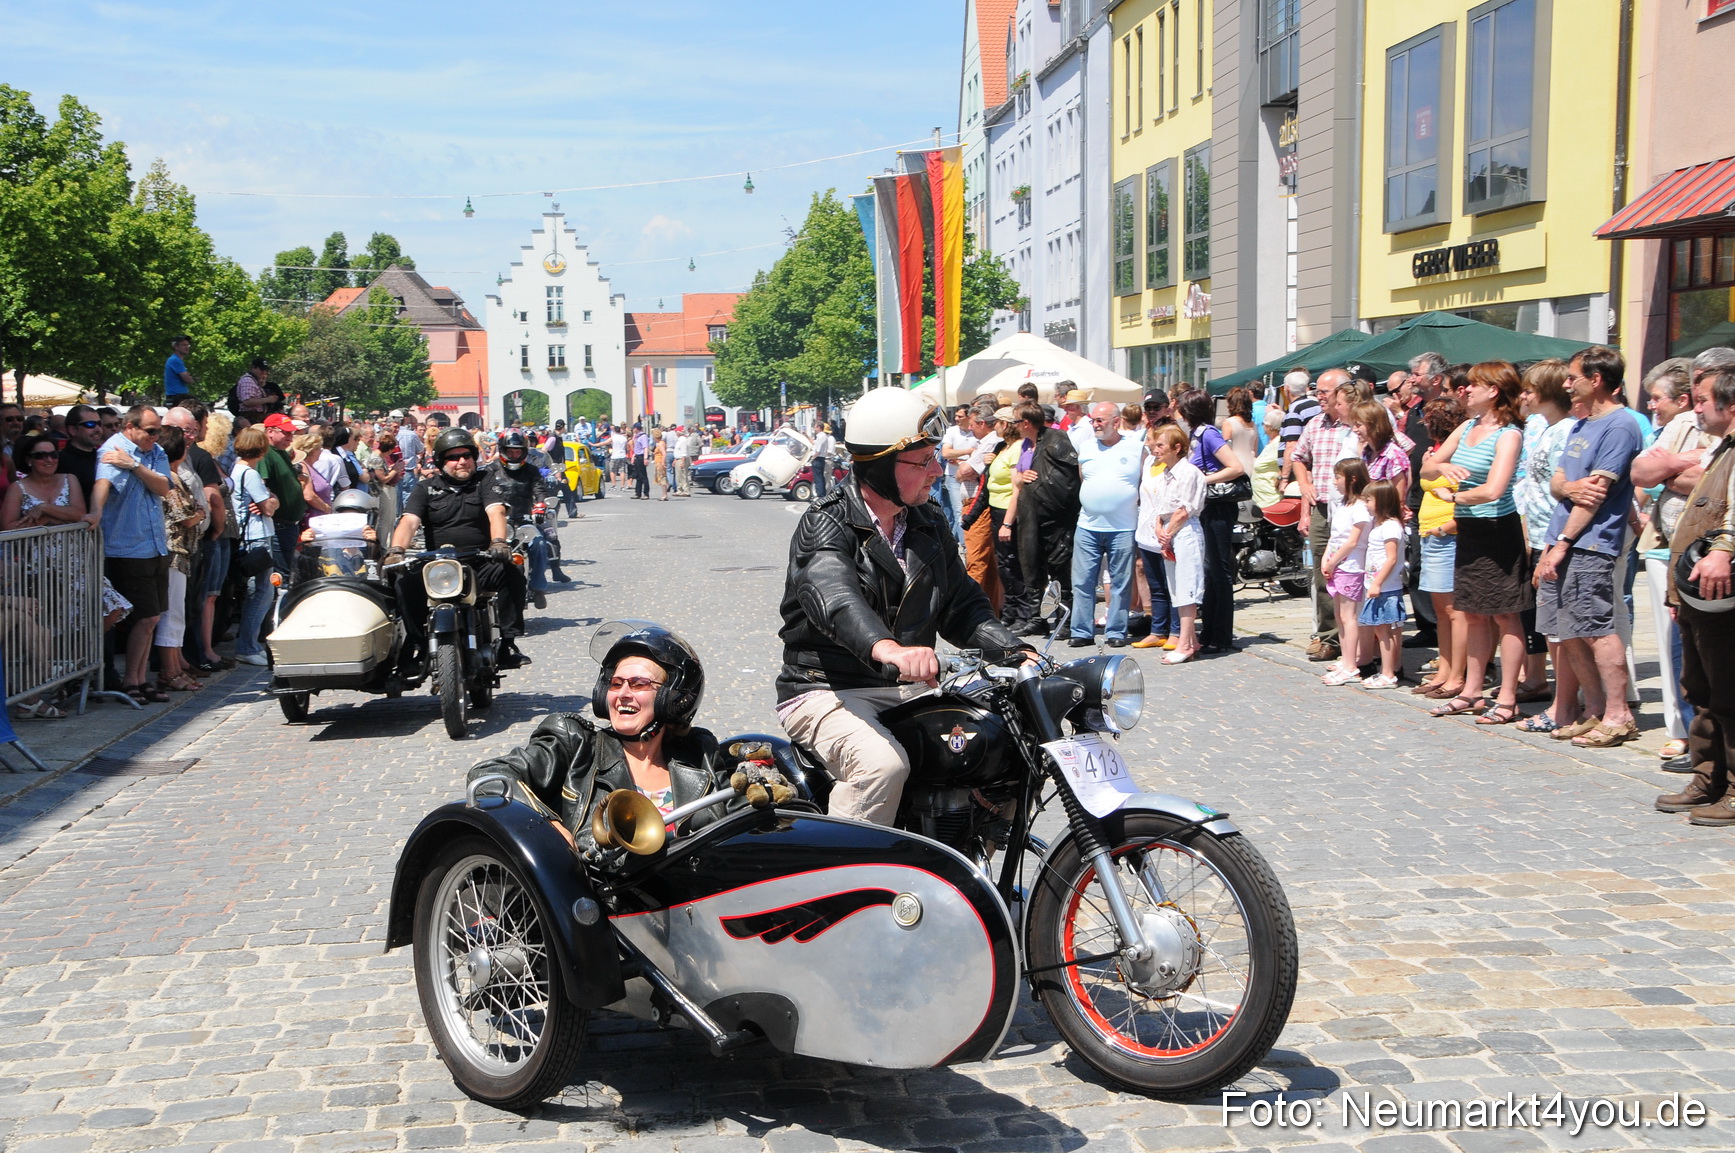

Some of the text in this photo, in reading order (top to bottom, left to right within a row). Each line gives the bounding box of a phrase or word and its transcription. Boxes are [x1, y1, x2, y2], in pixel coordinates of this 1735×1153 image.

[1412, 239, 1499, 279] GERRY WEBER
[1085, 748, 1119, 779] 413
